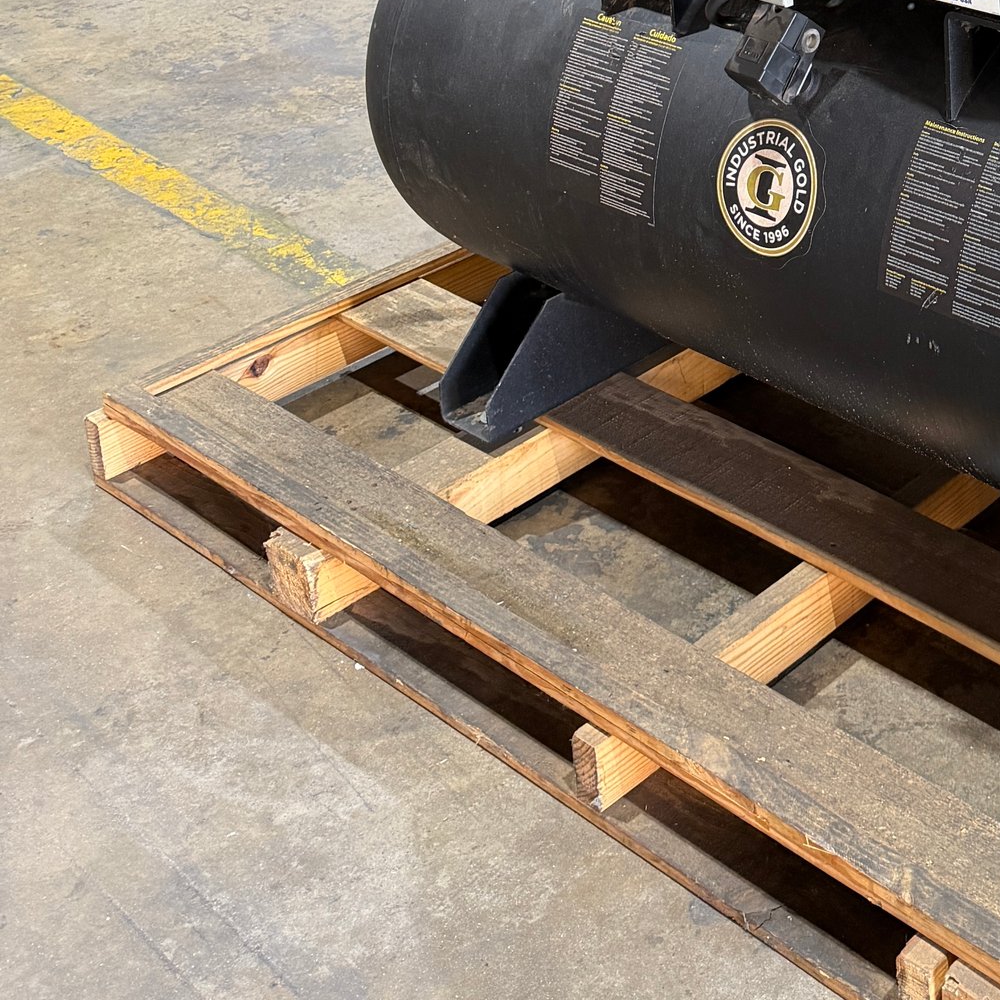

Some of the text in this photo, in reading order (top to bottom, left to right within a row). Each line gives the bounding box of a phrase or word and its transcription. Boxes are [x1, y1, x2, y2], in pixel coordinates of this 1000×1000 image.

[649, 29, 677, 43] Cuidado
[924, 120, 986, 144] Maintenance Instructions
[726, 131, 808, 215] INDUSTRIAL GOLD
[729, 204, 790, 243] SINCE 1996
